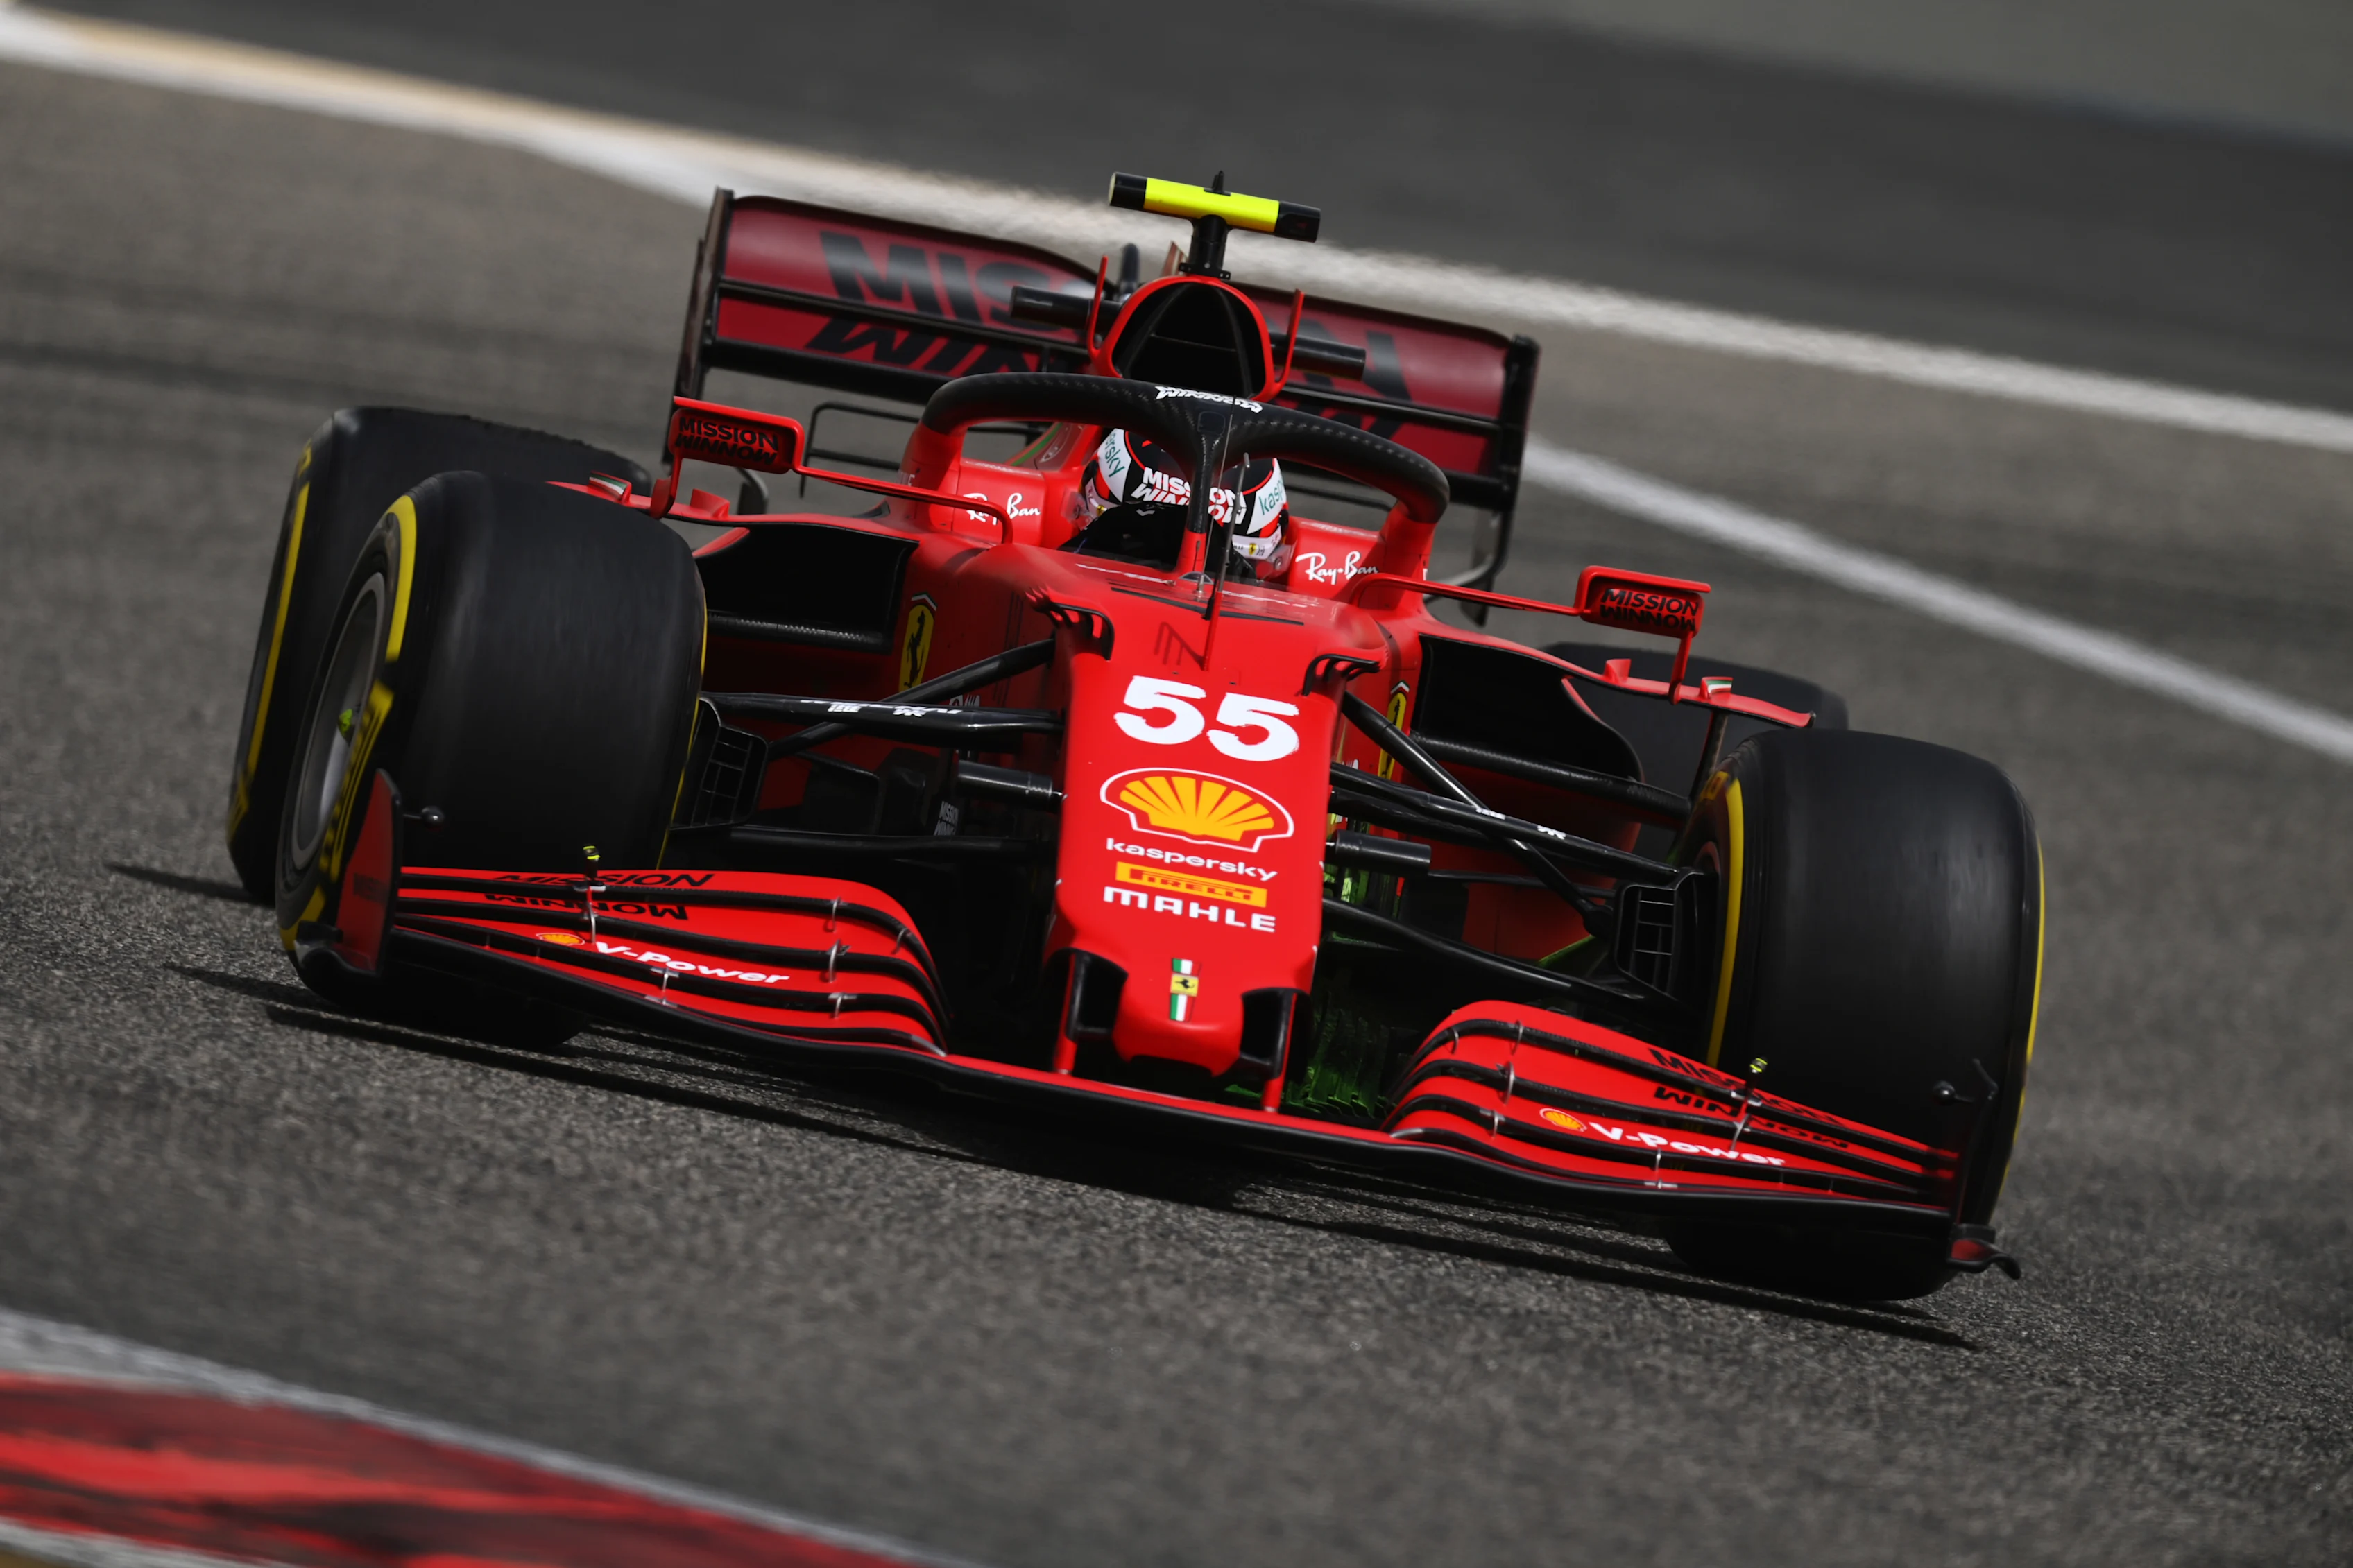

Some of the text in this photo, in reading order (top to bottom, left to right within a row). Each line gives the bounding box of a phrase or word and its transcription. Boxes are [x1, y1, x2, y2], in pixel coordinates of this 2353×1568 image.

[674, 433, 778, 465] WINNOW
[678, 417, 778, 451] MISSION
[1599, 603, 1697, 632] WINNOW
[1600, 588, 1700, 617] MISSION
[1113, 675, 1300, 761] 55
[1106, 837, 1278, 882] kaspersky
[1129, 868, 1253, 901] PIRELLI
[1103, 886, 1276, 933] MAHLE
[595, 941, 790, 984] V-Power
[1589, 1121, 1786, 1166] V-Power
